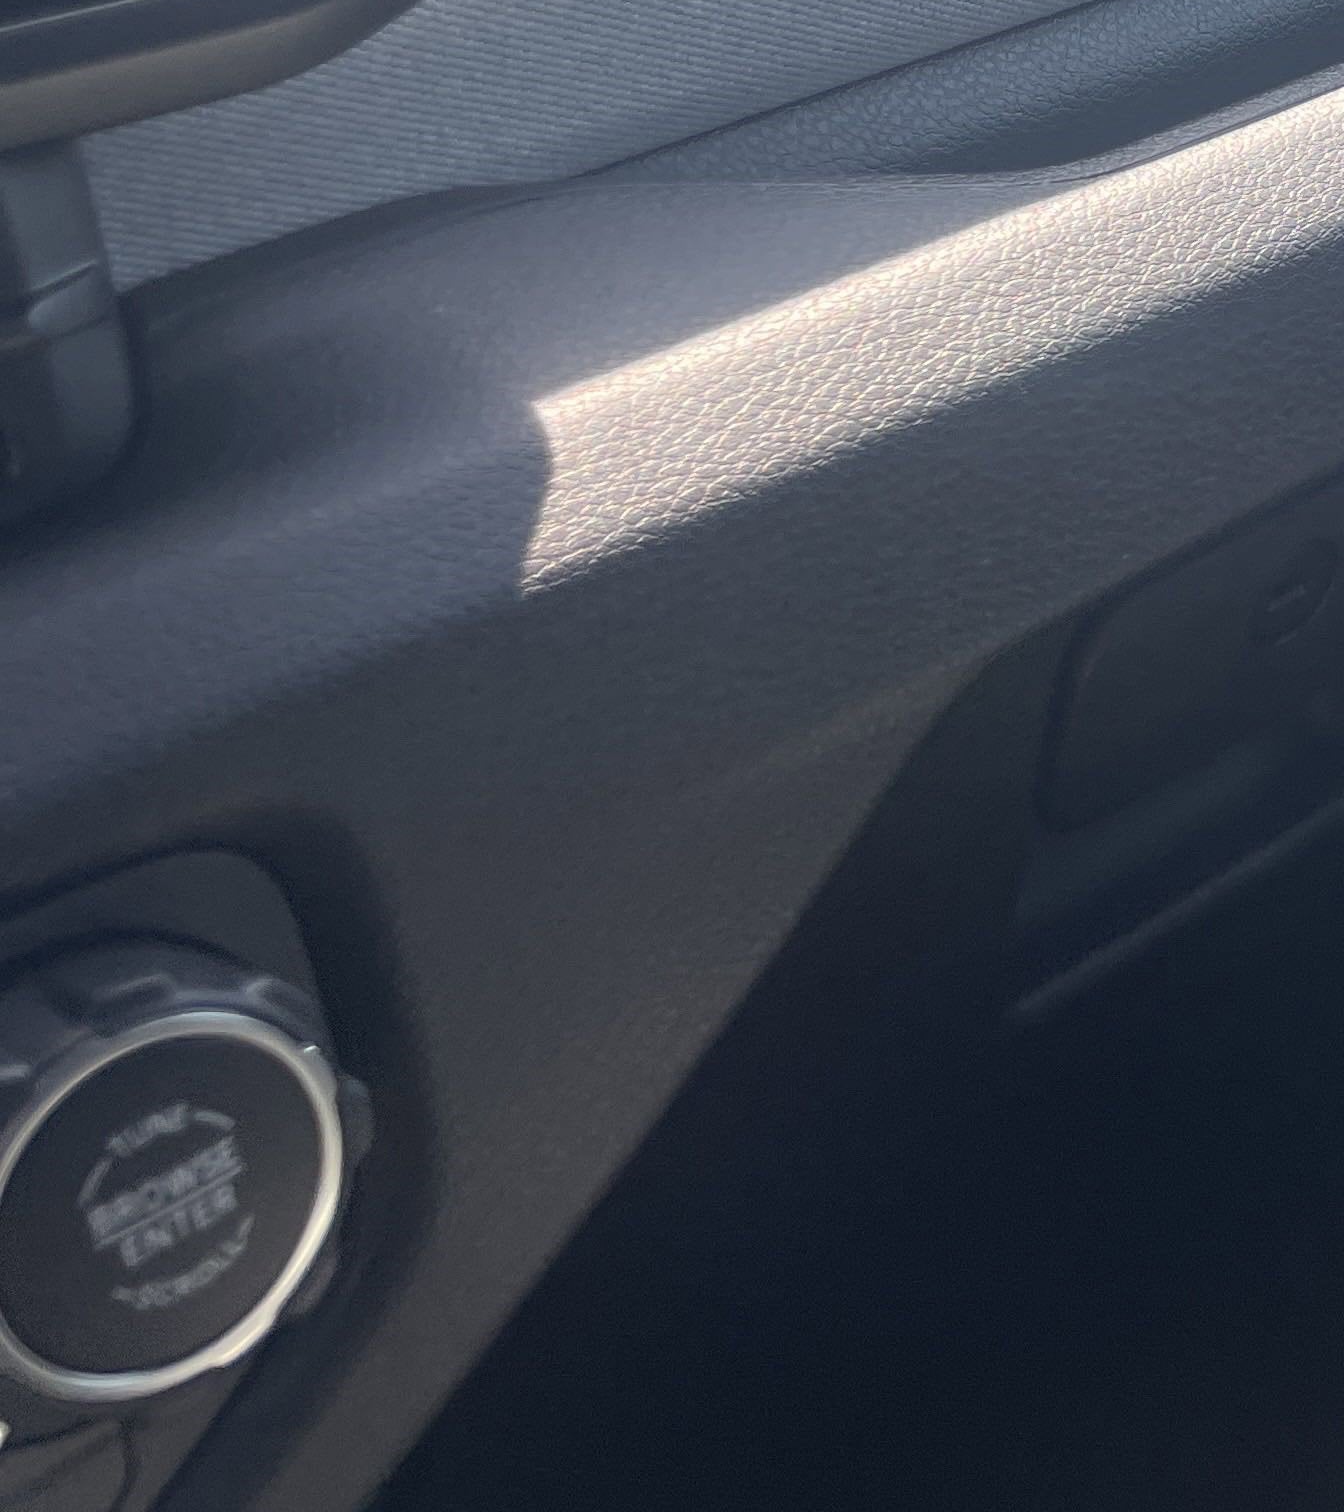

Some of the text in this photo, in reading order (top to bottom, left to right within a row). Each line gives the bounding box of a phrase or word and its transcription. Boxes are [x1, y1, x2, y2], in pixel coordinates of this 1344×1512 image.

[106, 1102, 190, 1157] TUNE
[87, 1137, 237, 1238] BROWSE
[120, 1183, 238, 1268] ENTER
